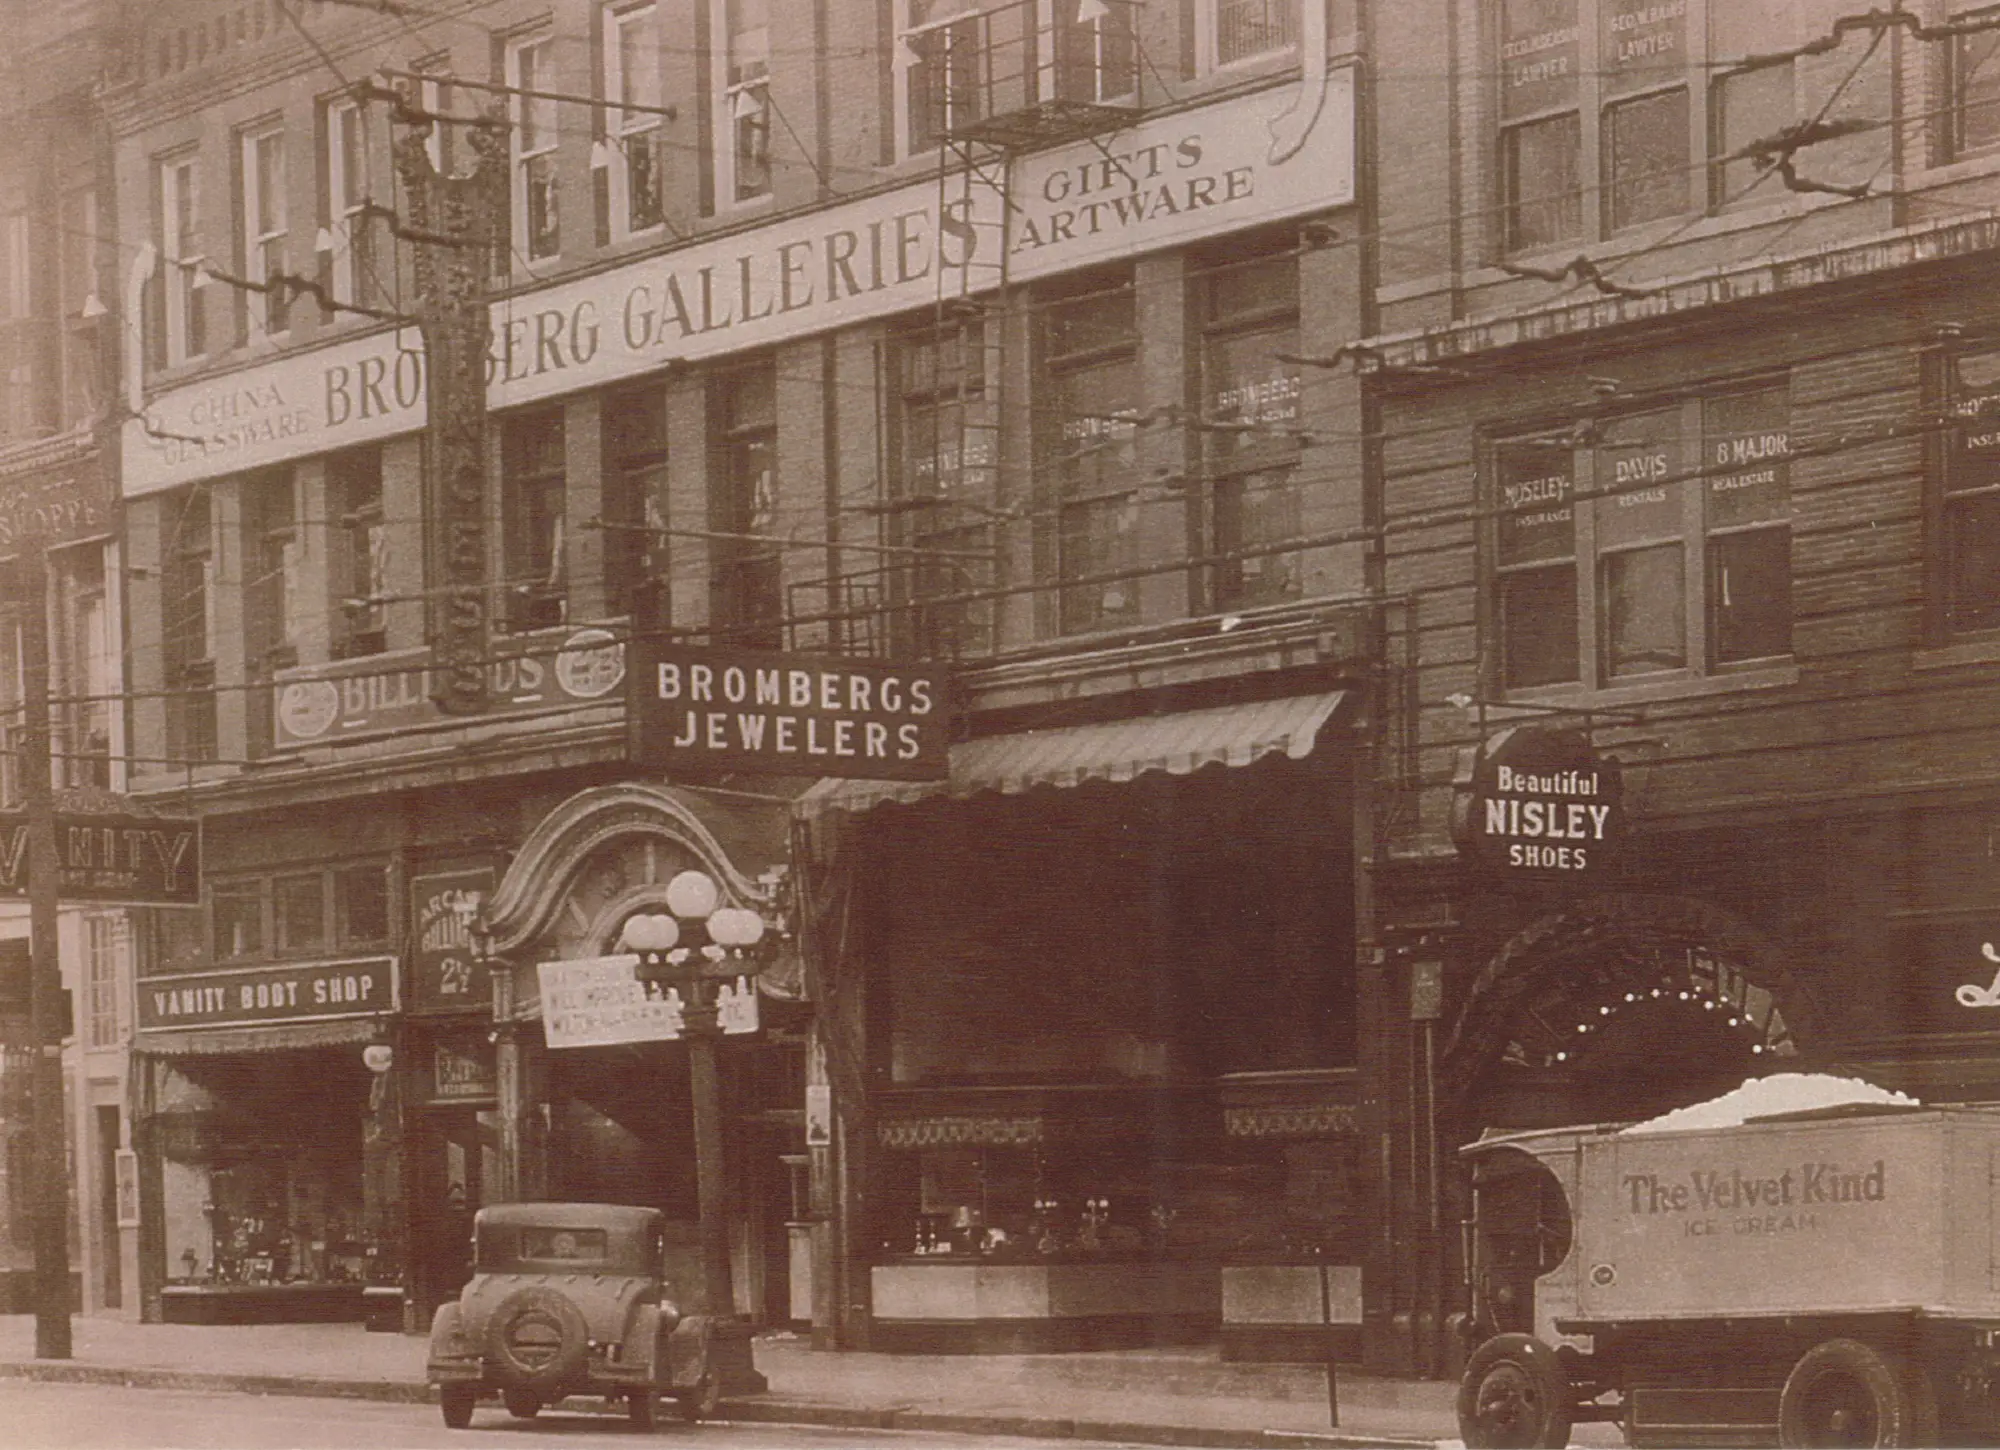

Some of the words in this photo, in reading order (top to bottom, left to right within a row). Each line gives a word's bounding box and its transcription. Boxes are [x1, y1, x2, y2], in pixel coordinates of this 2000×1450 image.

[1619, 32, 1675, 62] LAWYER
[1513, 57, 1569, 87] LAWYER
[1044, 134, 1203, 204] GIFTS
[1011, 166, 1254, 255] ARTWARE
[324, 300, 601, 428] BROERG
[623, 197, 978, 350] GALLERIES
[190, 380, 287, 426] CHINA
[162, 410, 309, 466] GLASSWARE
[1615, 454, 1667, 482] DAVIS
[343, 656, 545, 716] BILLIDS
[657, 661, 933, 715] BROMBERGS
[673, 710, 920, 760] JEWELERS
[1498, 765, 1598, 795] Beautiful
[1484, 798, 1610, 840] NISLEY
[0, 825, 193, 892] VNITY
[1509, 844, 1587, 870] SHOES
[154, 987, 225, 1016] VANITY
[240, 981, 298, 1009] BOOT
[313, 974, 373, 1004] SHOP
[1623, 1174, 1690, 1214] The
[1690, 1168, 1793, 1212] Velvet
[1802, 1159, 1886, 1204] Kind
[1684, 1218, 1719, 1238] ICE
[1732, 1213, 1816, 1236] CREAM
